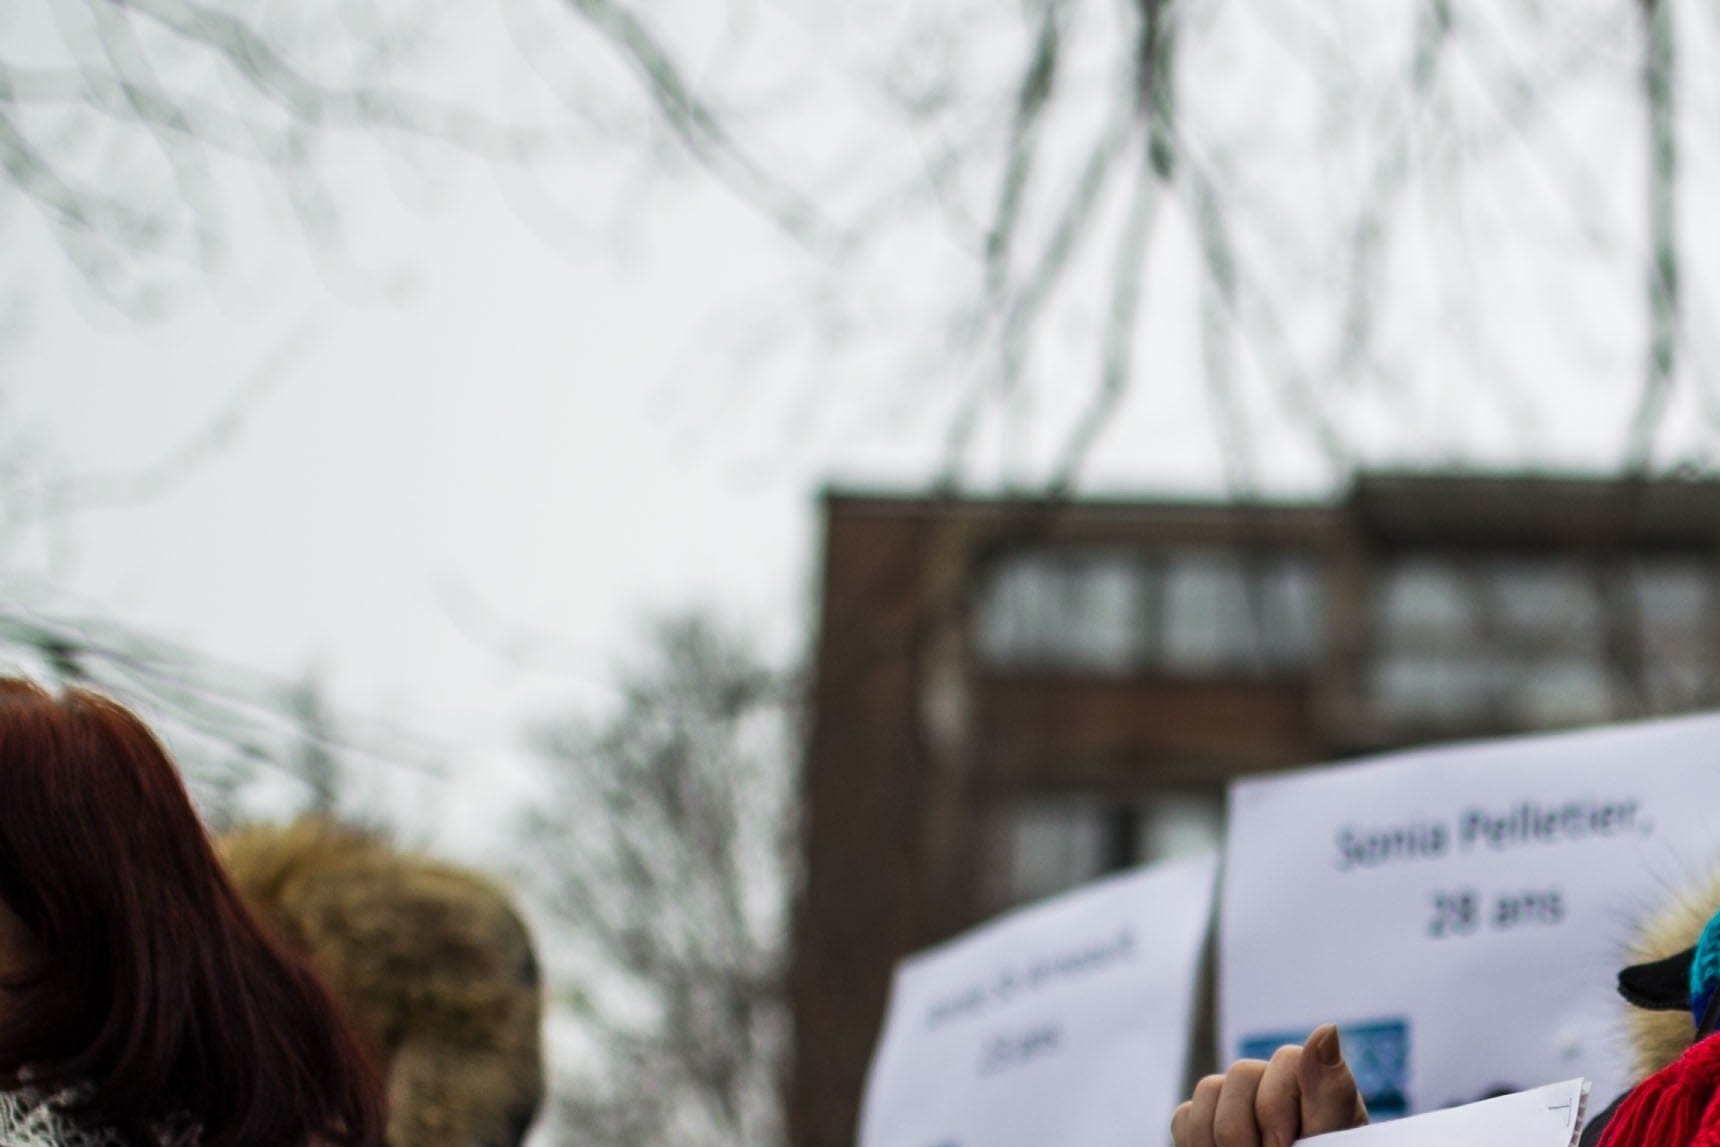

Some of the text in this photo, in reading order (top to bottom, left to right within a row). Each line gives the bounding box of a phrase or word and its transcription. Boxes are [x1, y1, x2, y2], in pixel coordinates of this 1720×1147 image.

[1336, 824, 1448, 870] Sonia
[1427, 886, 1568, 938] 28 ans
